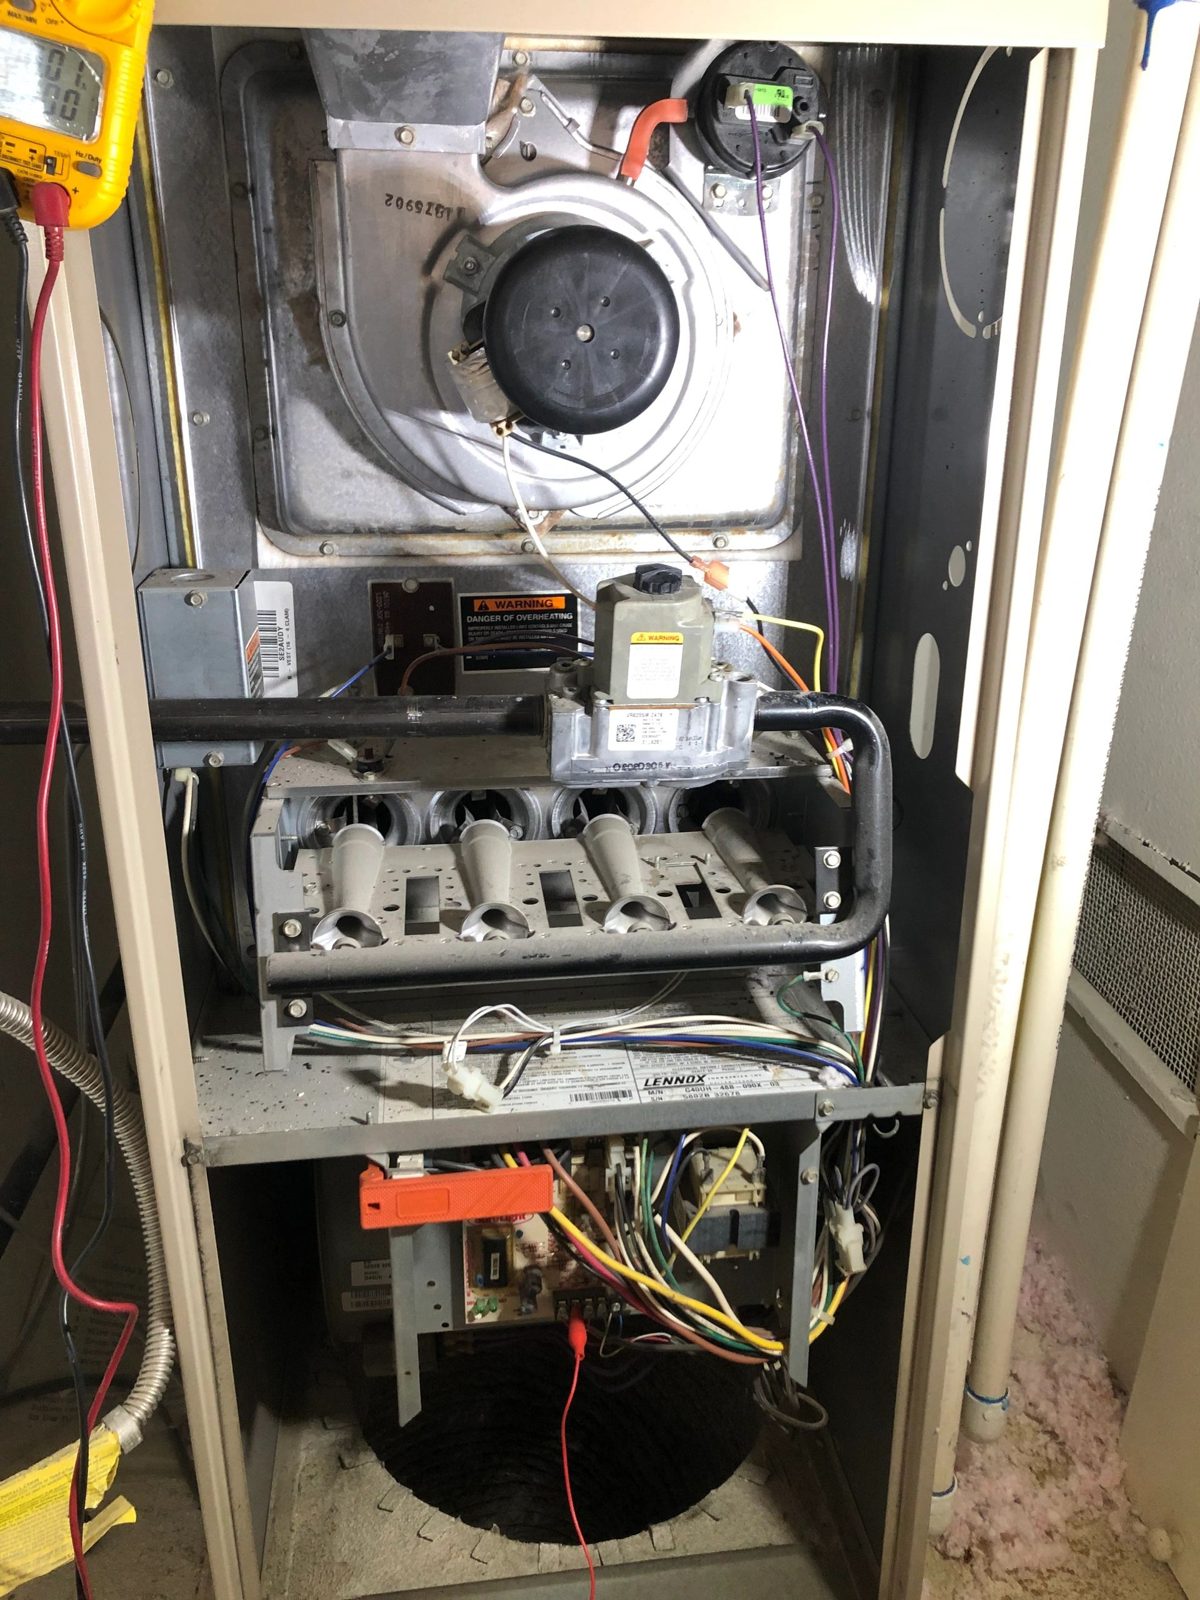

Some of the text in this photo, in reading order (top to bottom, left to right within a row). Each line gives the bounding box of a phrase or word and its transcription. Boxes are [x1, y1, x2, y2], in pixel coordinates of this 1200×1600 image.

[494, 599, 554, 610] WARNING
[466, 612, 573, 623] DANGER OF OVERHEATING
[643, 1074, 706, 1087] LENNOX
